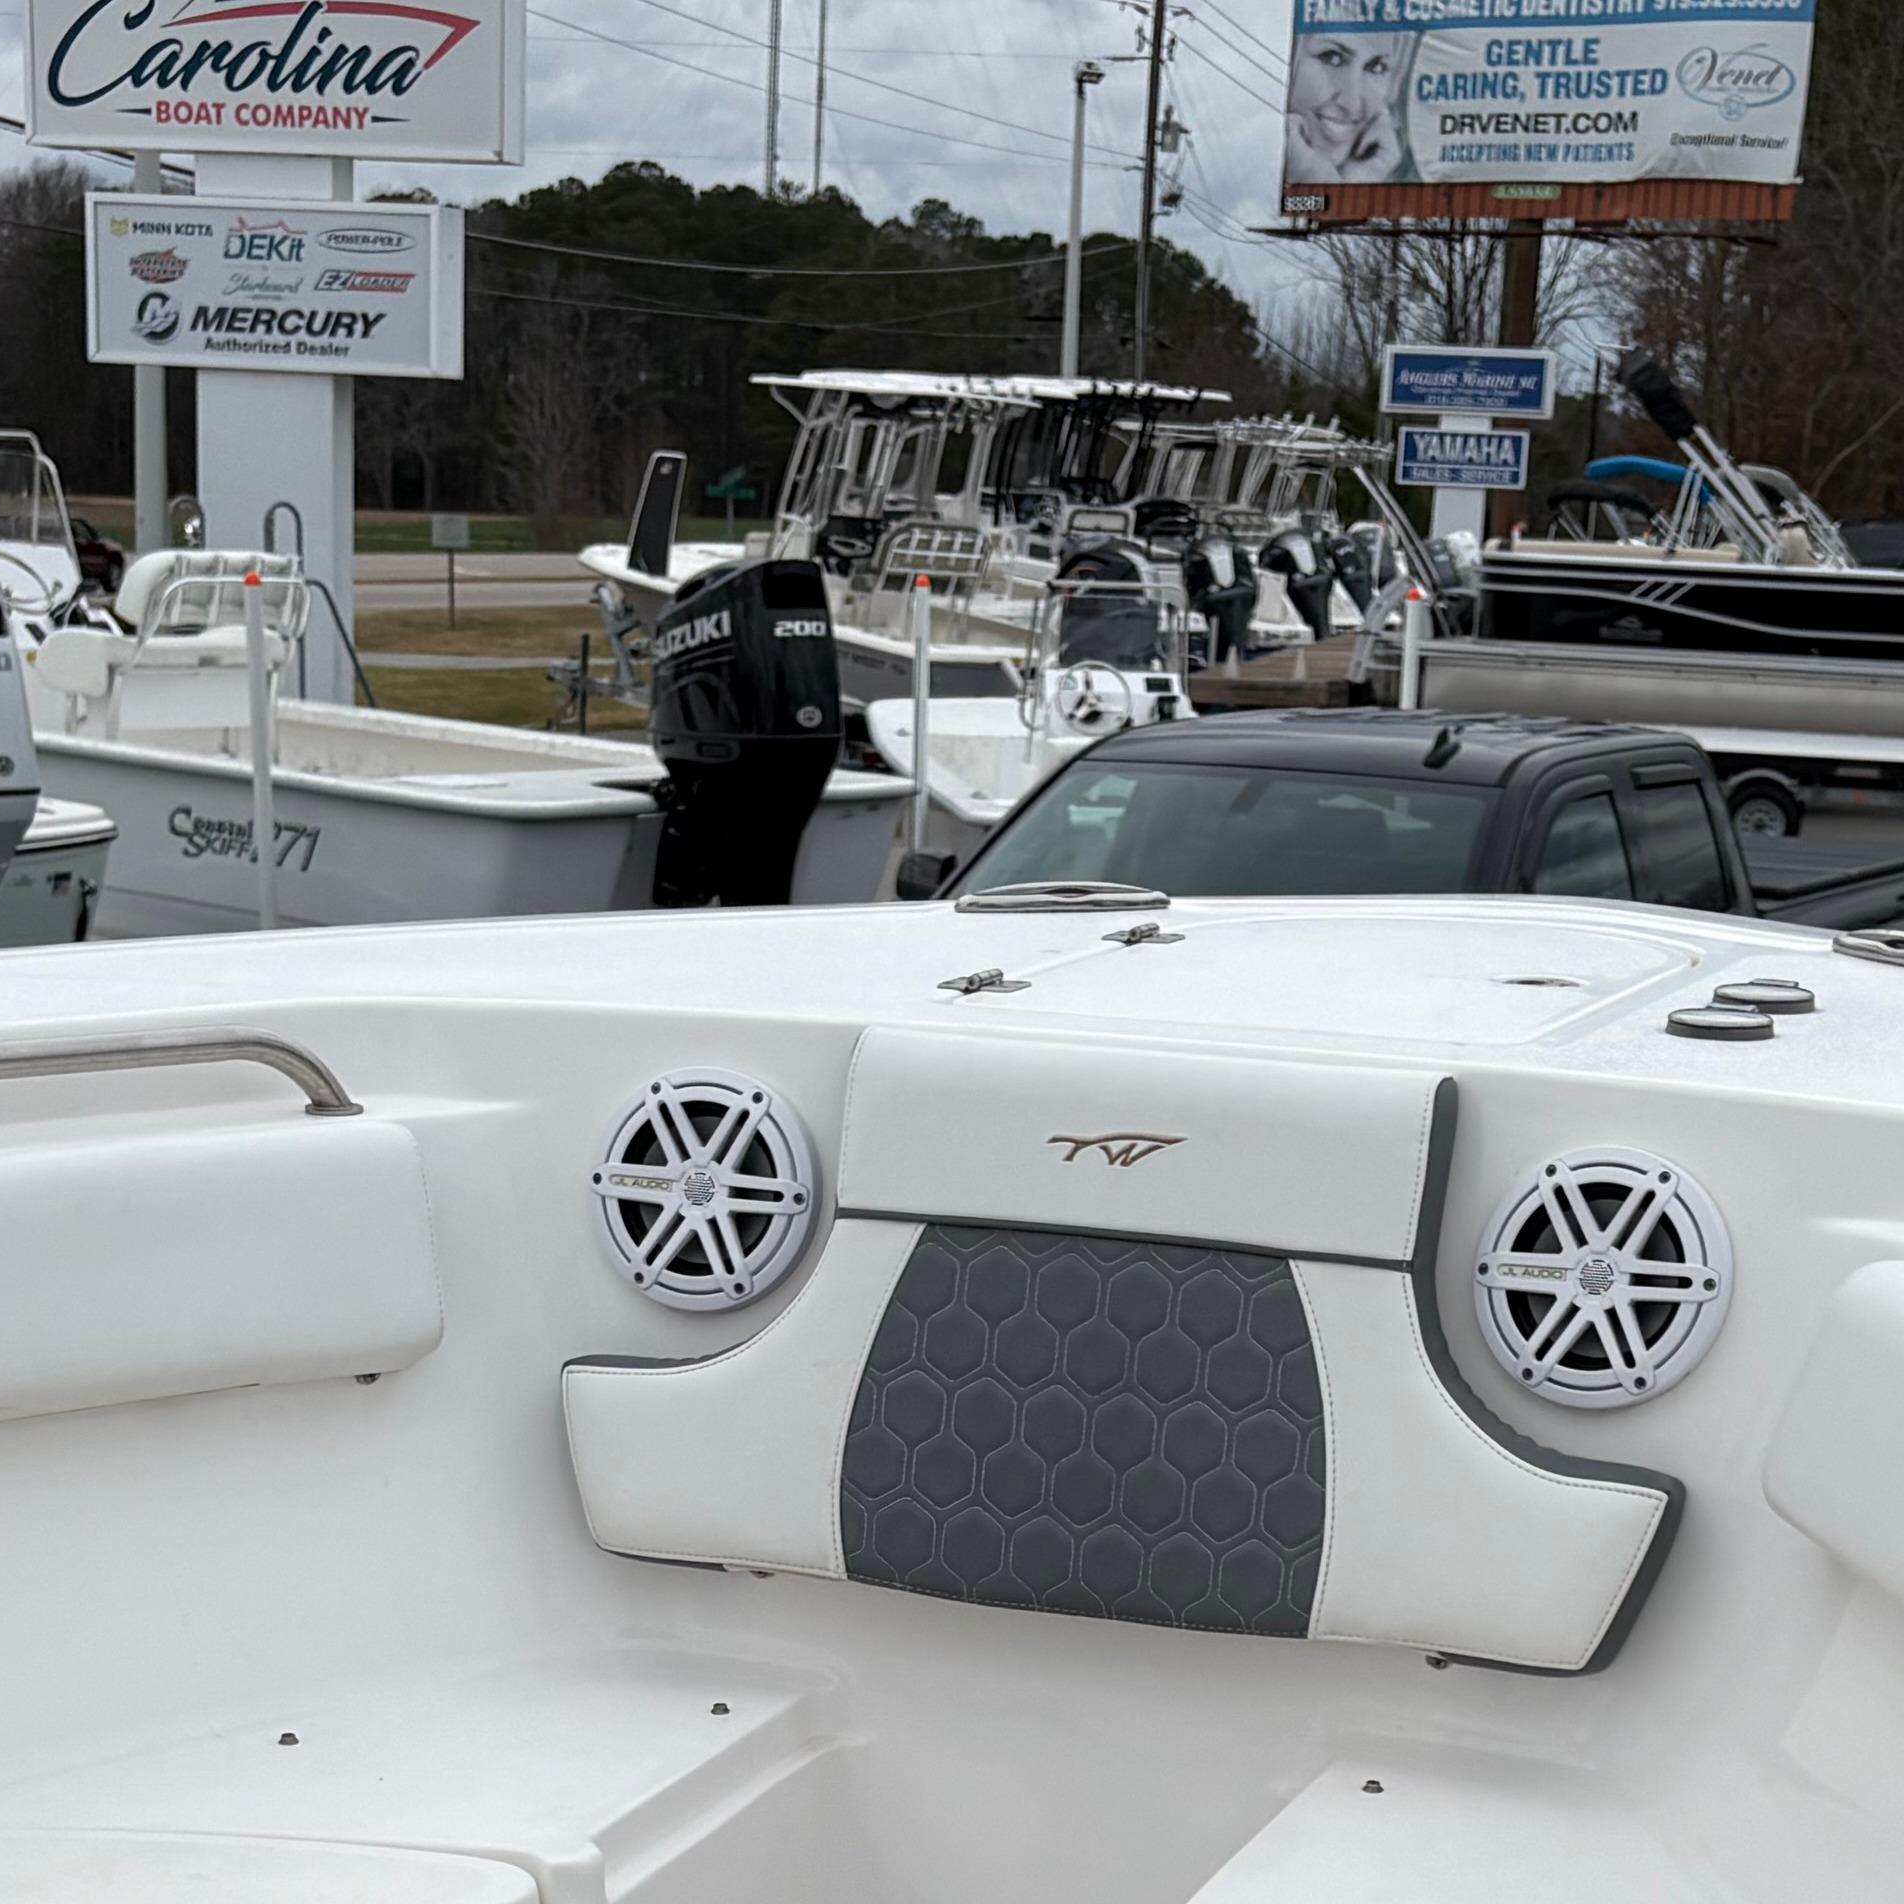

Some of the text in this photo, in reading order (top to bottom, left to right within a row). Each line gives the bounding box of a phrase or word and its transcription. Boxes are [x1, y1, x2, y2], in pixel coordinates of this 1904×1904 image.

[47, 0, 424, 107] Carolina
[1485, 38, 1601, 67] GENTLE
[1416, 68, 1669, 102] CARING, TRUSTED
[155, 101, 371, 130] BOAT COMPANY
[1439, 111, 1639, 135] DRVENET.COM
[1523, 143, 1560, 162] NEW
[189, 305, 387, 339] MERCURY
[203, 336, 350, 357] Authorized Dealer
[1412, 433, 1517, 466] YAMAHA
[773, 619, 827, 638] 200
